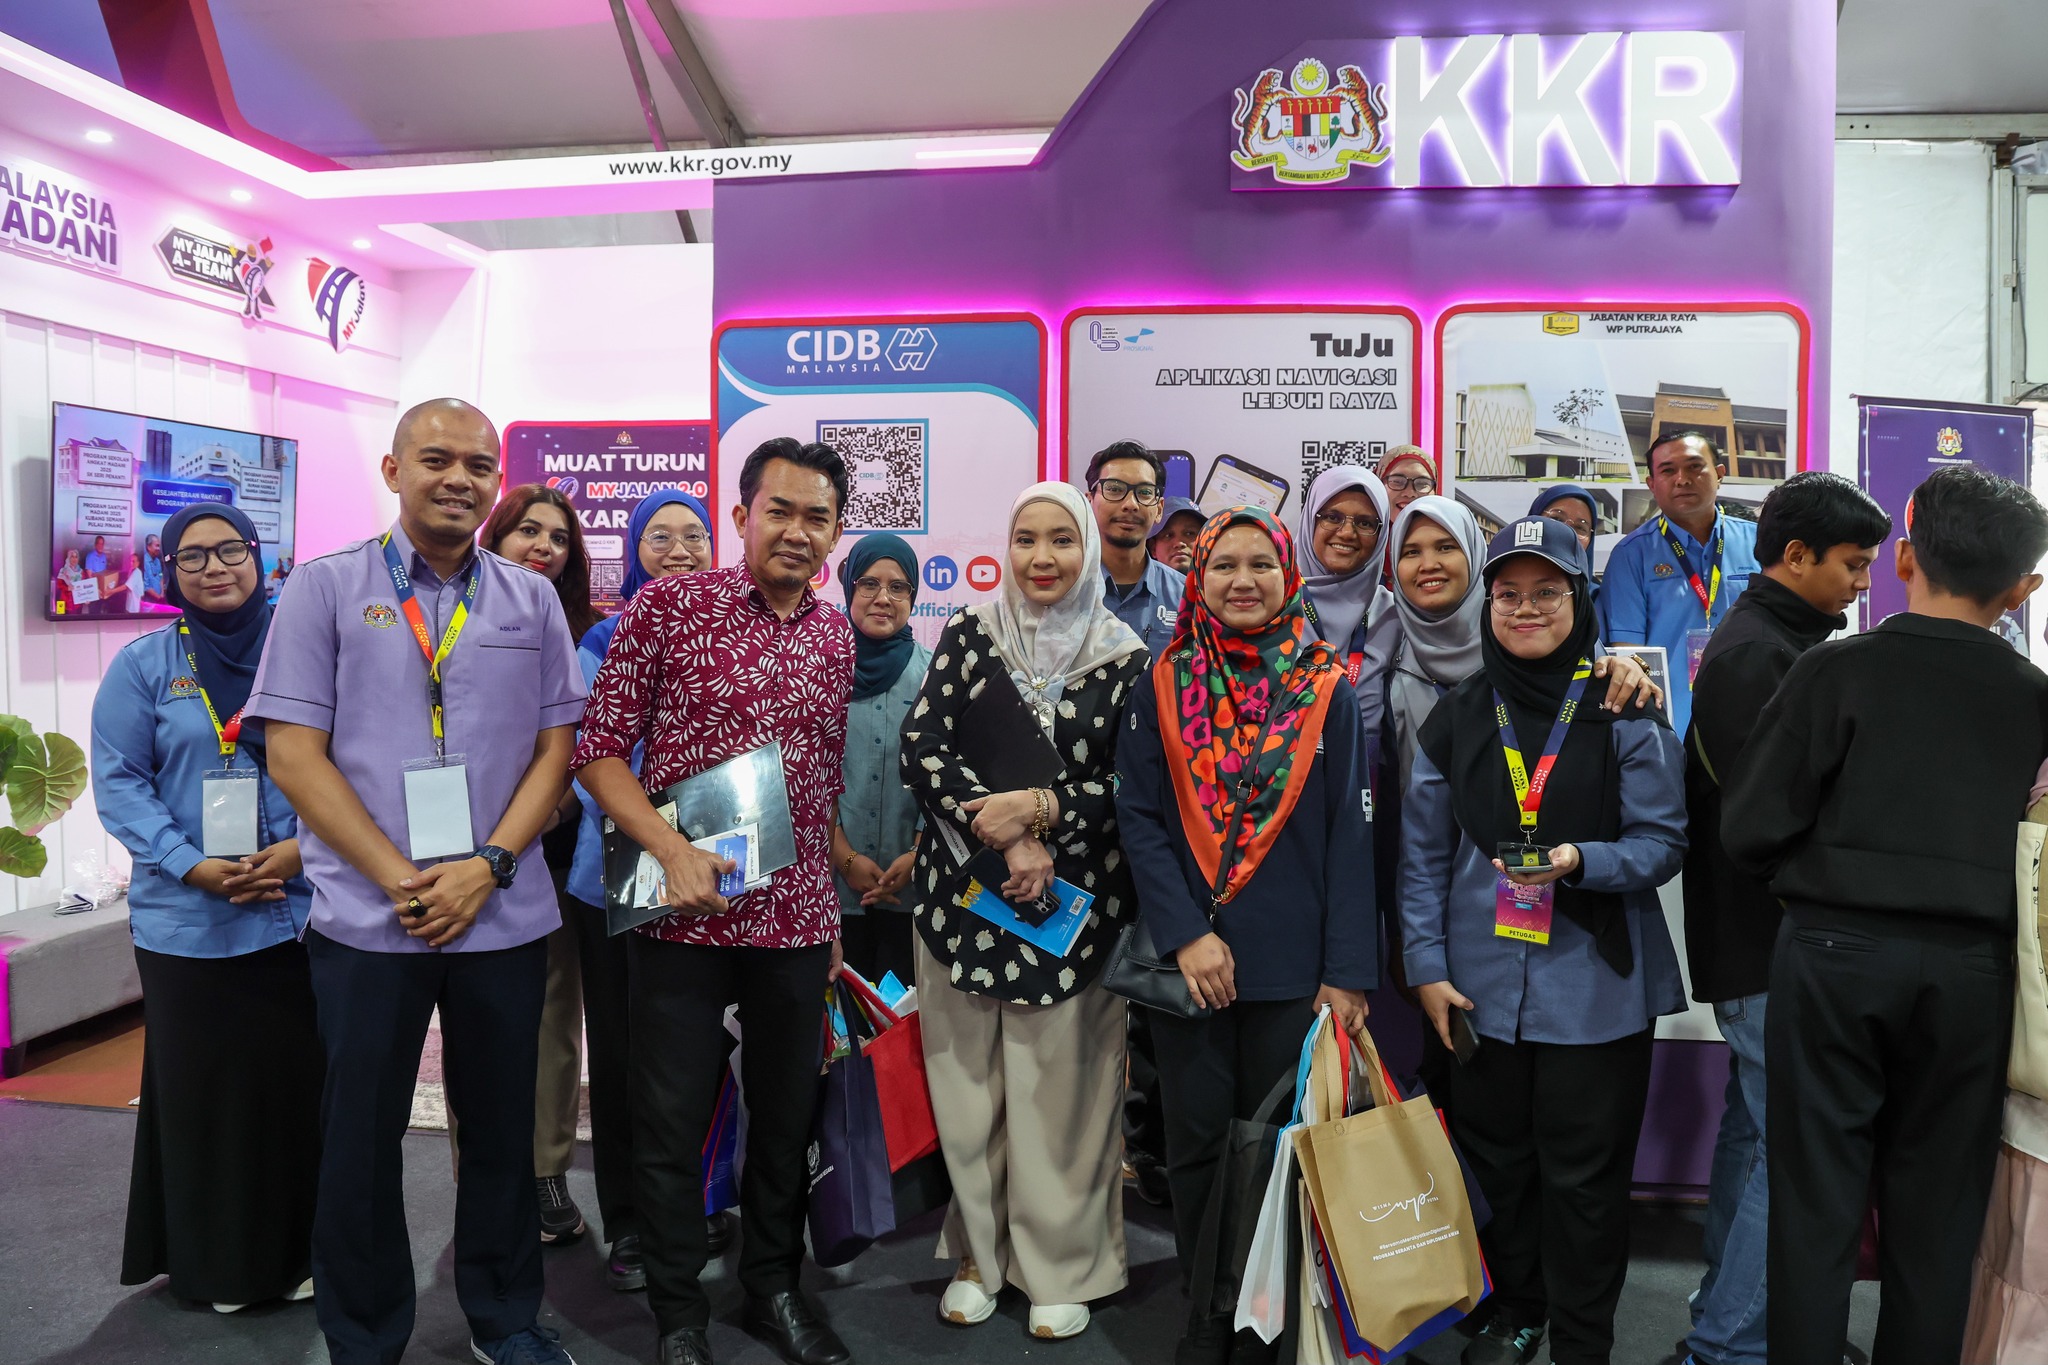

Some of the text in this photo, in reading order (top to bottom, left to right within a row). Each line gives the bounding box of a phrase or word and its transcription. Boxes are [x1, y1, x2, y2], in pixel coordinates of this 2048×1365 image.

[1394, 30, 1740, 186] KKR
[609, 154, 793, 175] www.kkr.gov.my
[1251, 155, 1279, 166] BERSEKUTU
[0, 166, 116, 231] ALAYSIA
[1, 199, 117, 265] ADANI
[173, 236, 233, 267] MYJALAN
[192, 255, 234, 282] TEAM
[1589, 313, 1698, 322] JABATAN KERJA RAYA
[1606, 325, 1683, 333] WP PUTRAJAYA
[787, 330, 881, 362] CIDB
[1310, 333, 1394, 357] TuJu
[787, 363, 881, 374] MALAYSIA
[1156, 368, 1397, 386] APLIKASI NAVIGASI
[1242, 392, 1398, 410] LEBUH RAYA
[83, 452, 107, 460] PROGRAM
[544, 453, 705, 472] MUAT TURUN
[152, 488, 200, 499] KESEJAHTERAAN
[156, 498, 186, 508] PROGRAM
[1509, 929, 1536, 940] PETUGAS
[1372, 1202, 1391, 1211] WISMA
[1373, 1250, 1395, 1261] PROGRAM
